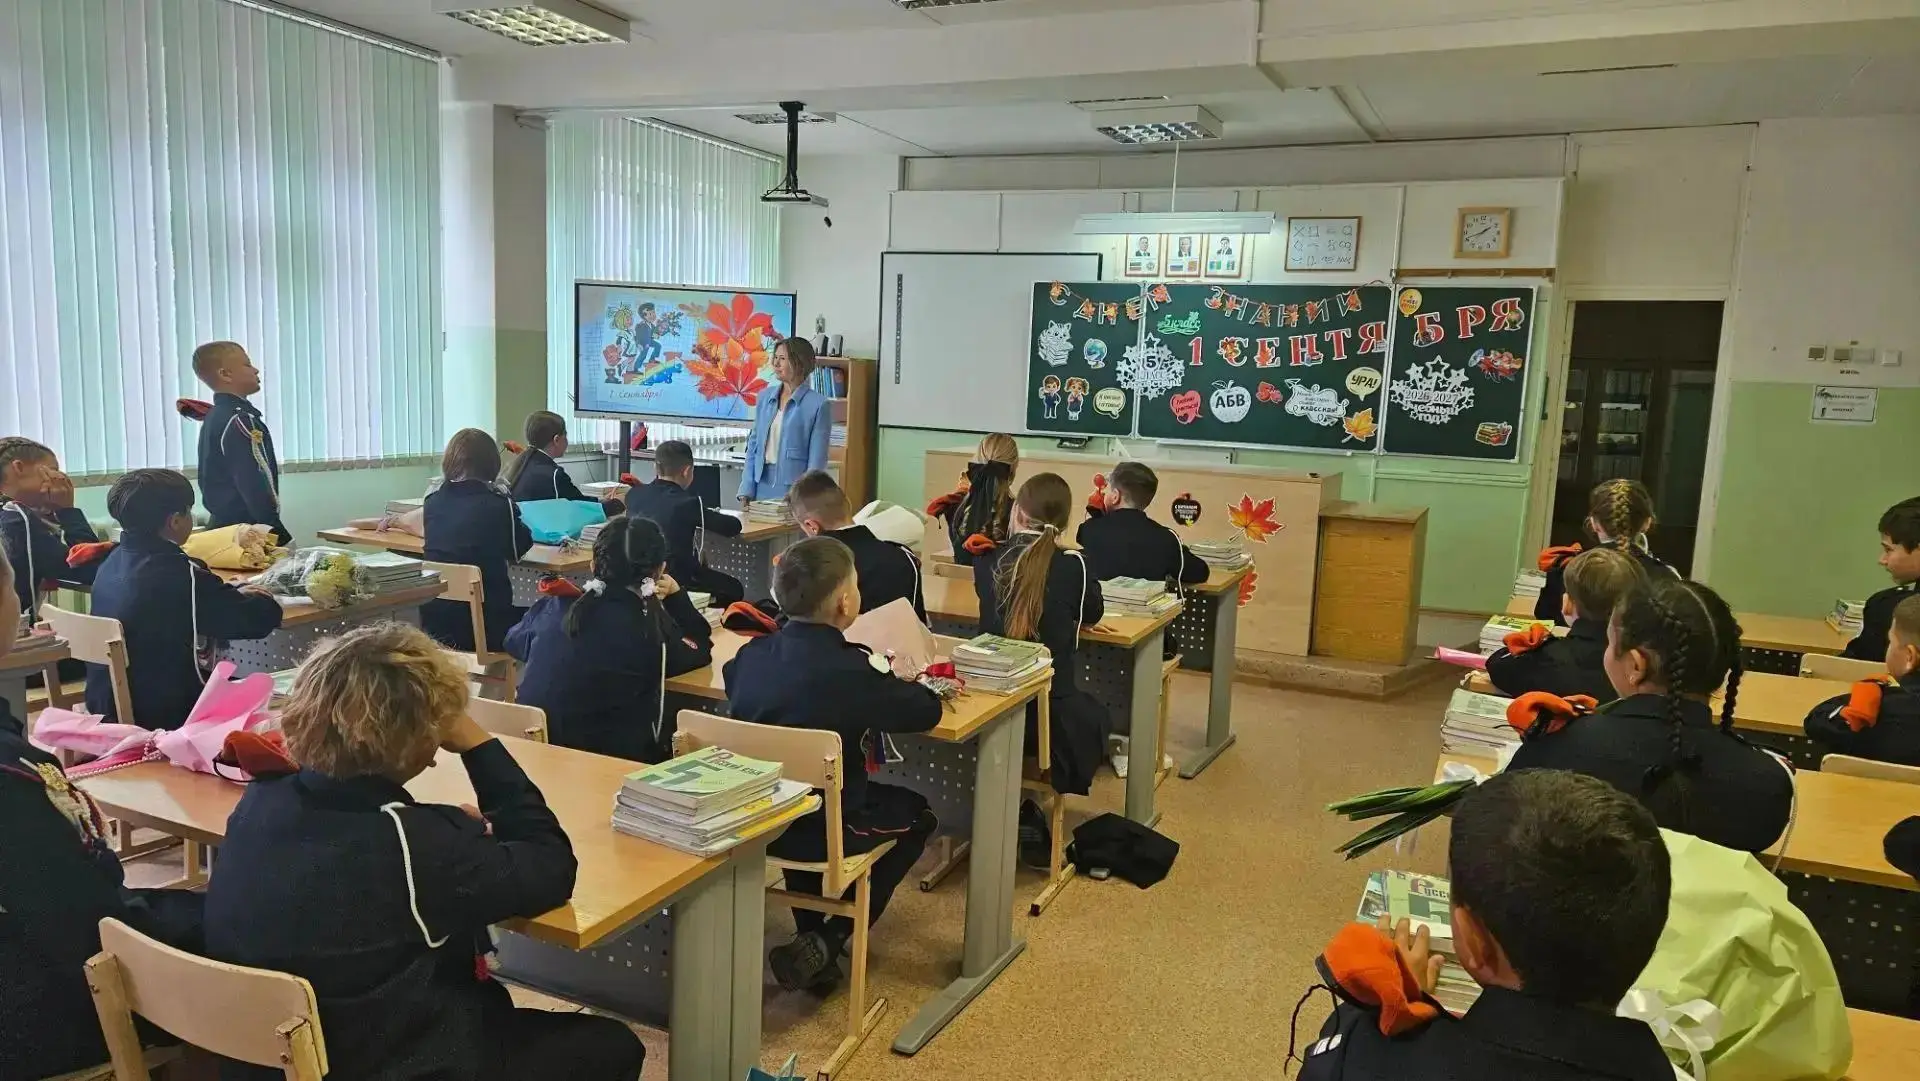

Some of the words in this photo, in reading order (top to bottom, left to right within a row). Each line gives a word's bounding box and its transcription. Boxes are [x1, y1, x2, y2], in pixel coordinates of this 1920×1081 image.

[1188, 337, 1204, 366] 1
[1145, 355, 1157, 369] 5
[1351, 370, 1378, 389] УРА!
[1215, 392, 1245, 409] АБВ
[1411, 878, 1450, 899] Русс
